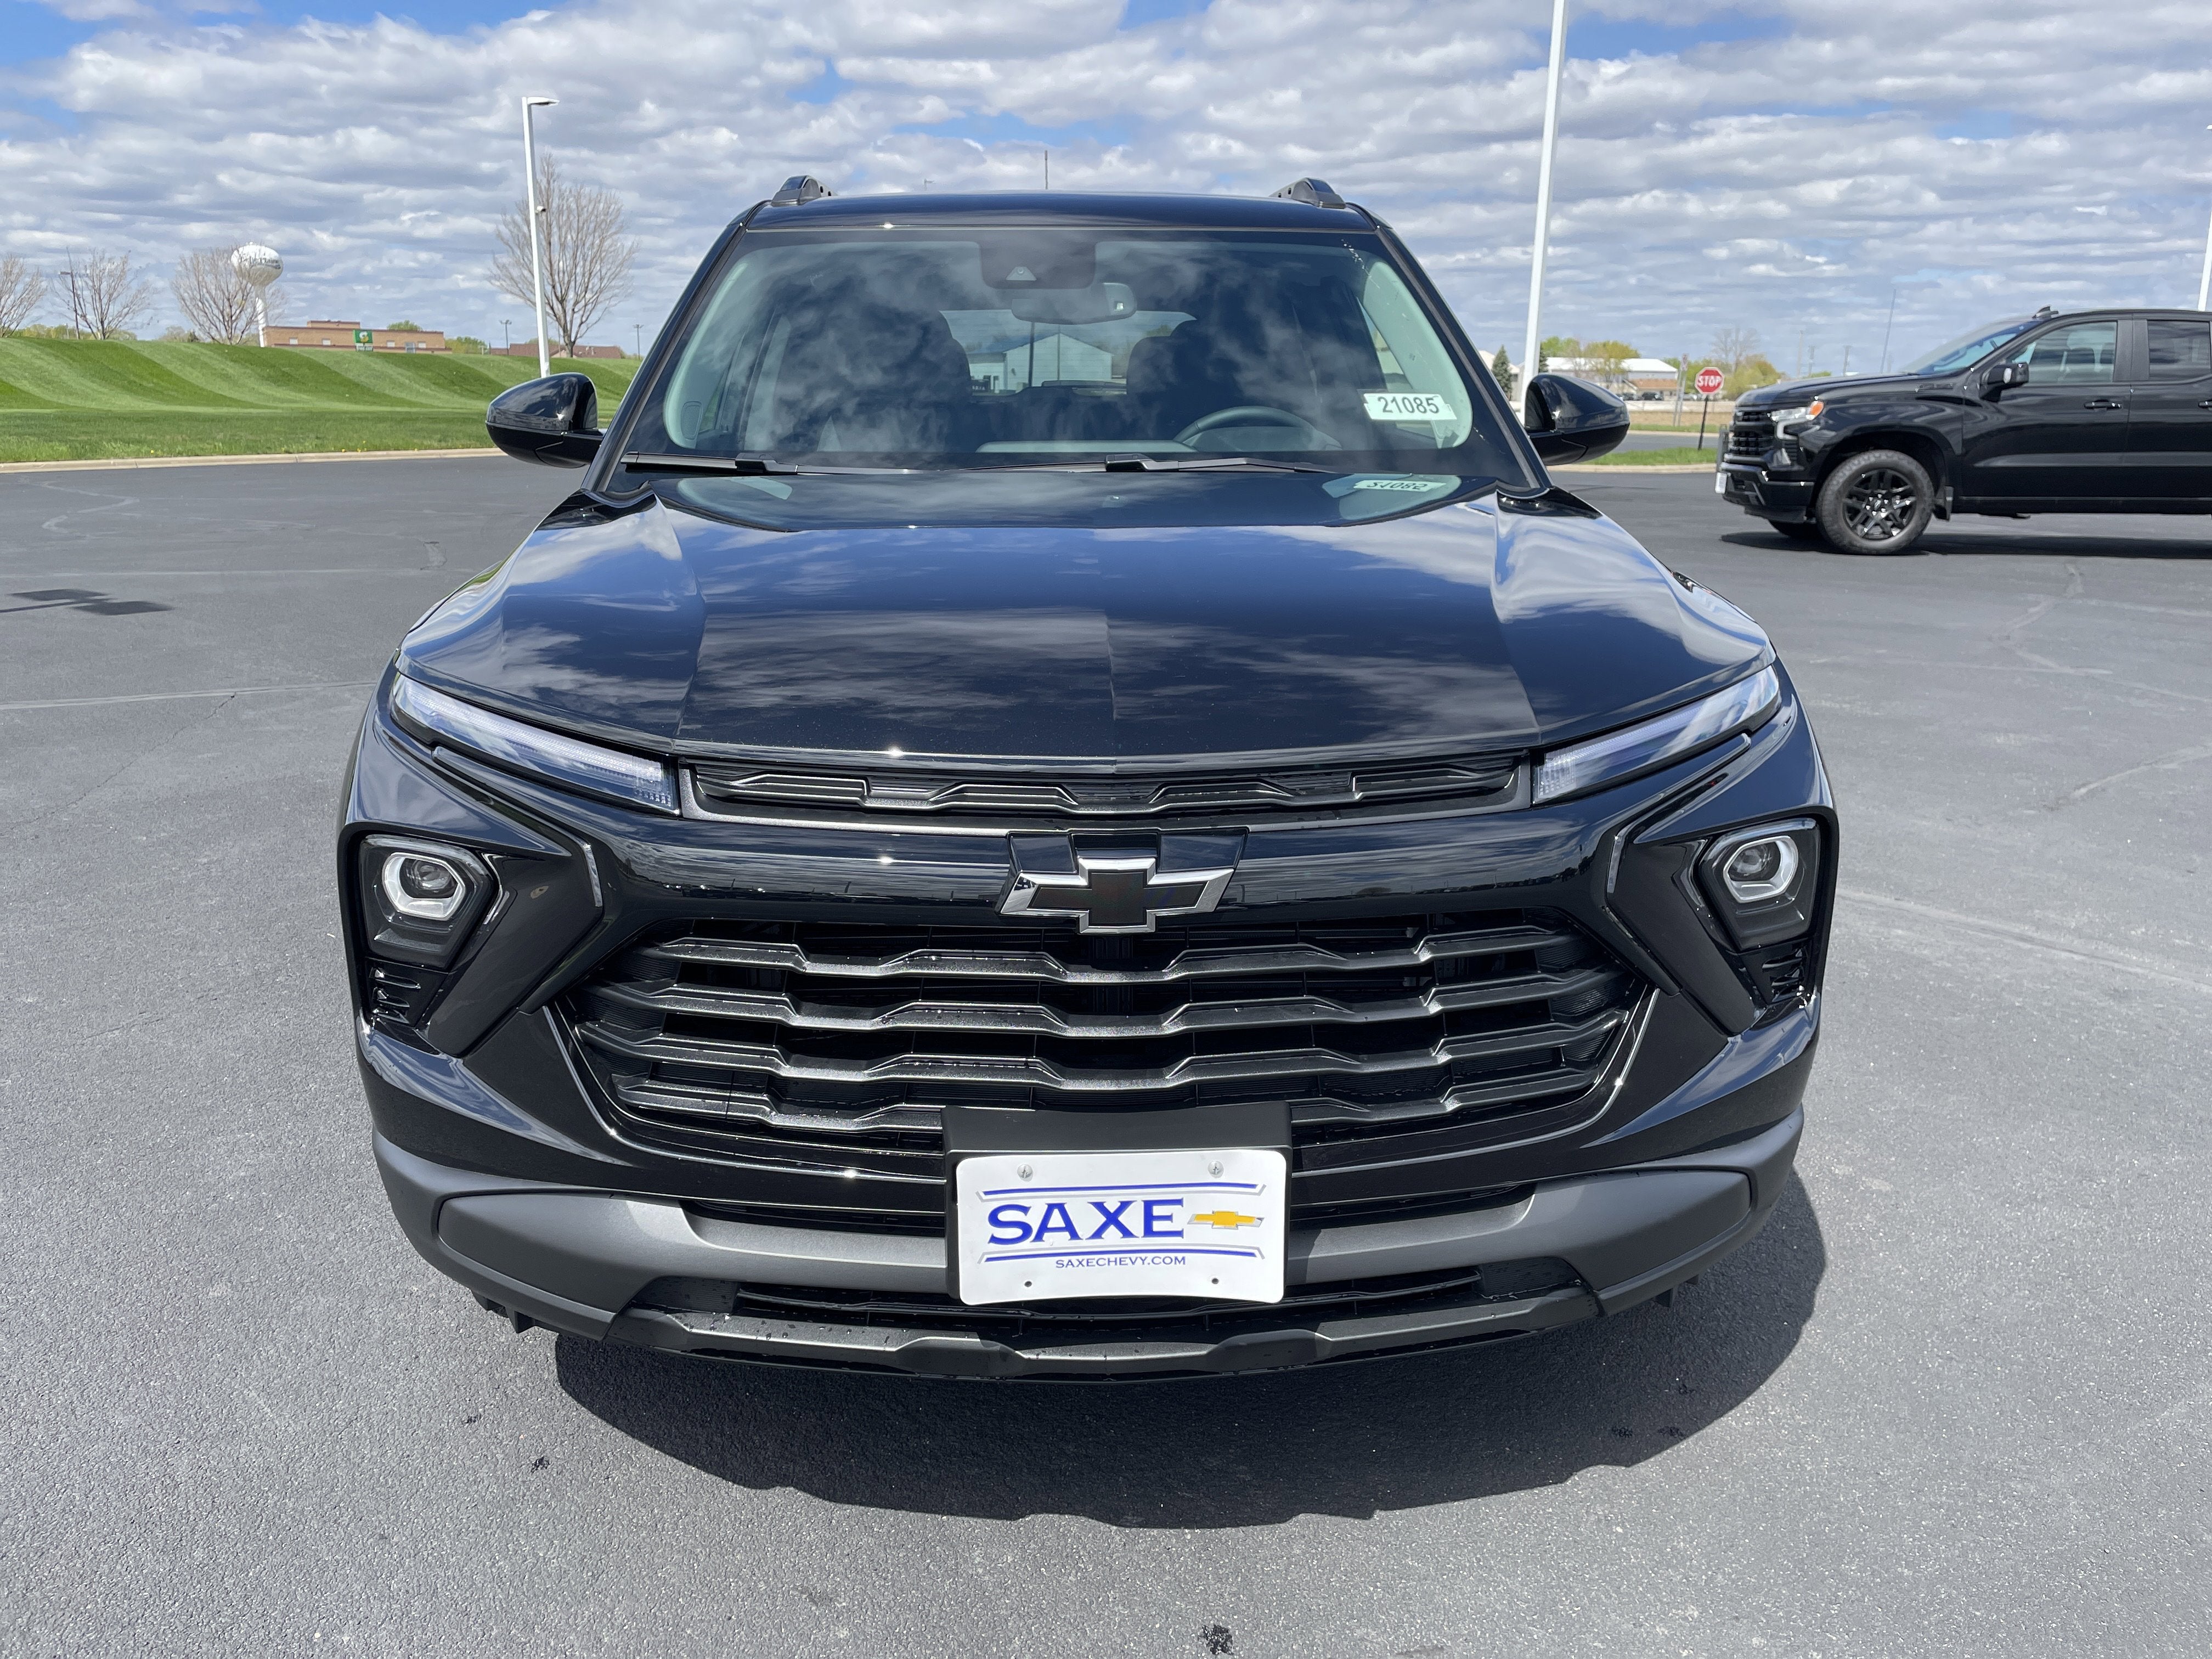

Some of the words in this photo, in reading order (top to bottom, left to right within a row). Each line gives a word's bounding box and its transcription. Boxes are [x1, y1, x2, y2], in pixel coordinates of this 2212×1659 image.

[1697, 375, 1722, 387] STOP
[1378, 396, 1439, 414] 21085
[988, 1198, 1184, 1245] SAXE
[1056, 1255, 1186, 1268] SAXECHEVY.COM
